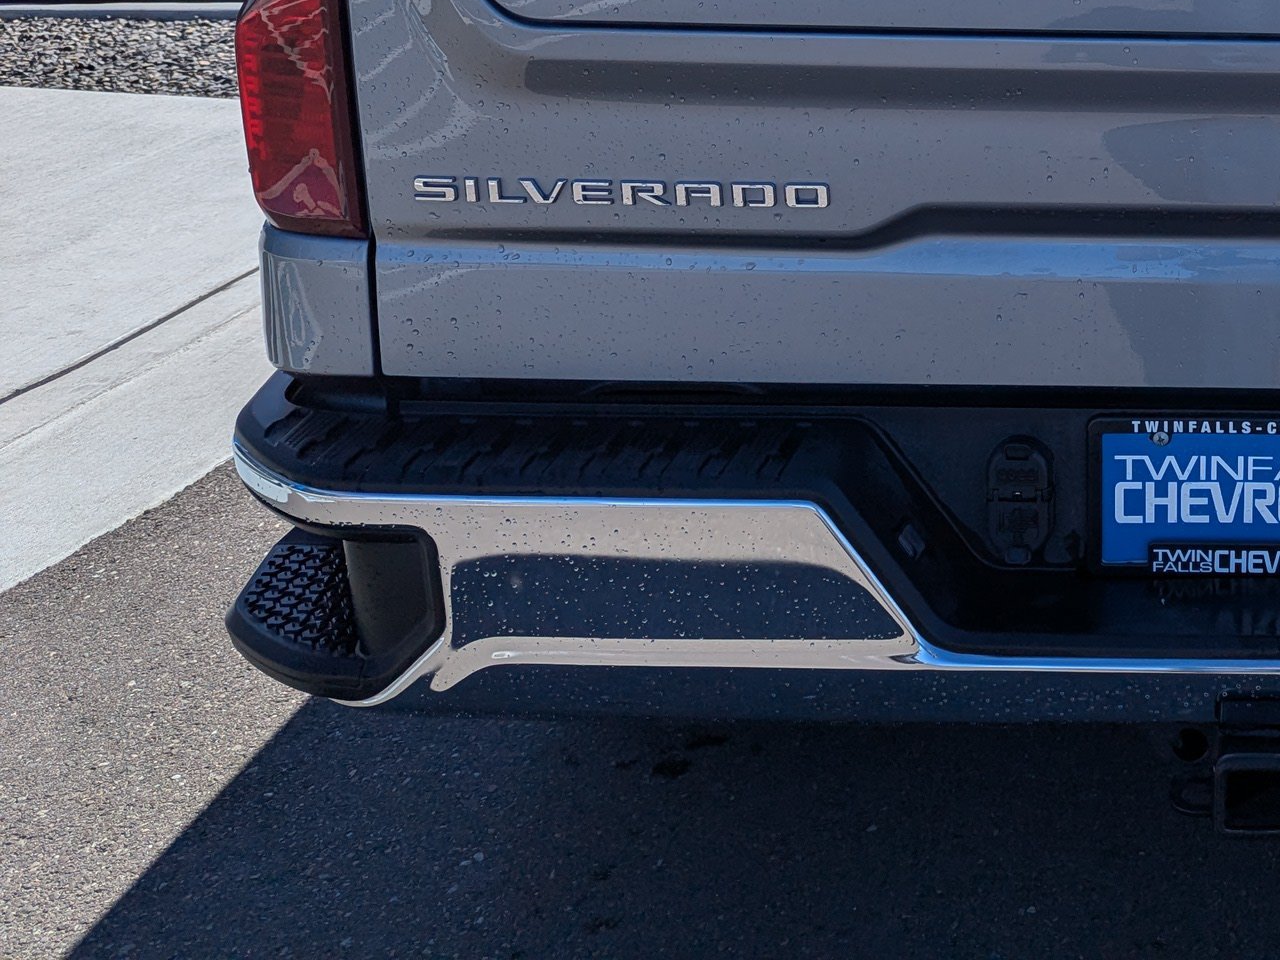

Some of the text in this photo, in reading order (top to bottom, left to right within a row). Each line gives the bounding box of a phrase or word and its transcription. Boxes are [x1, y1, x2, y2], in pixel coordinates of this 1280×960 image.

[413, 175, 831, 208] SILVERADO
[1153, 549, 1213, 562] TWIN
[1152, 561, 1213, 573] FALLS
